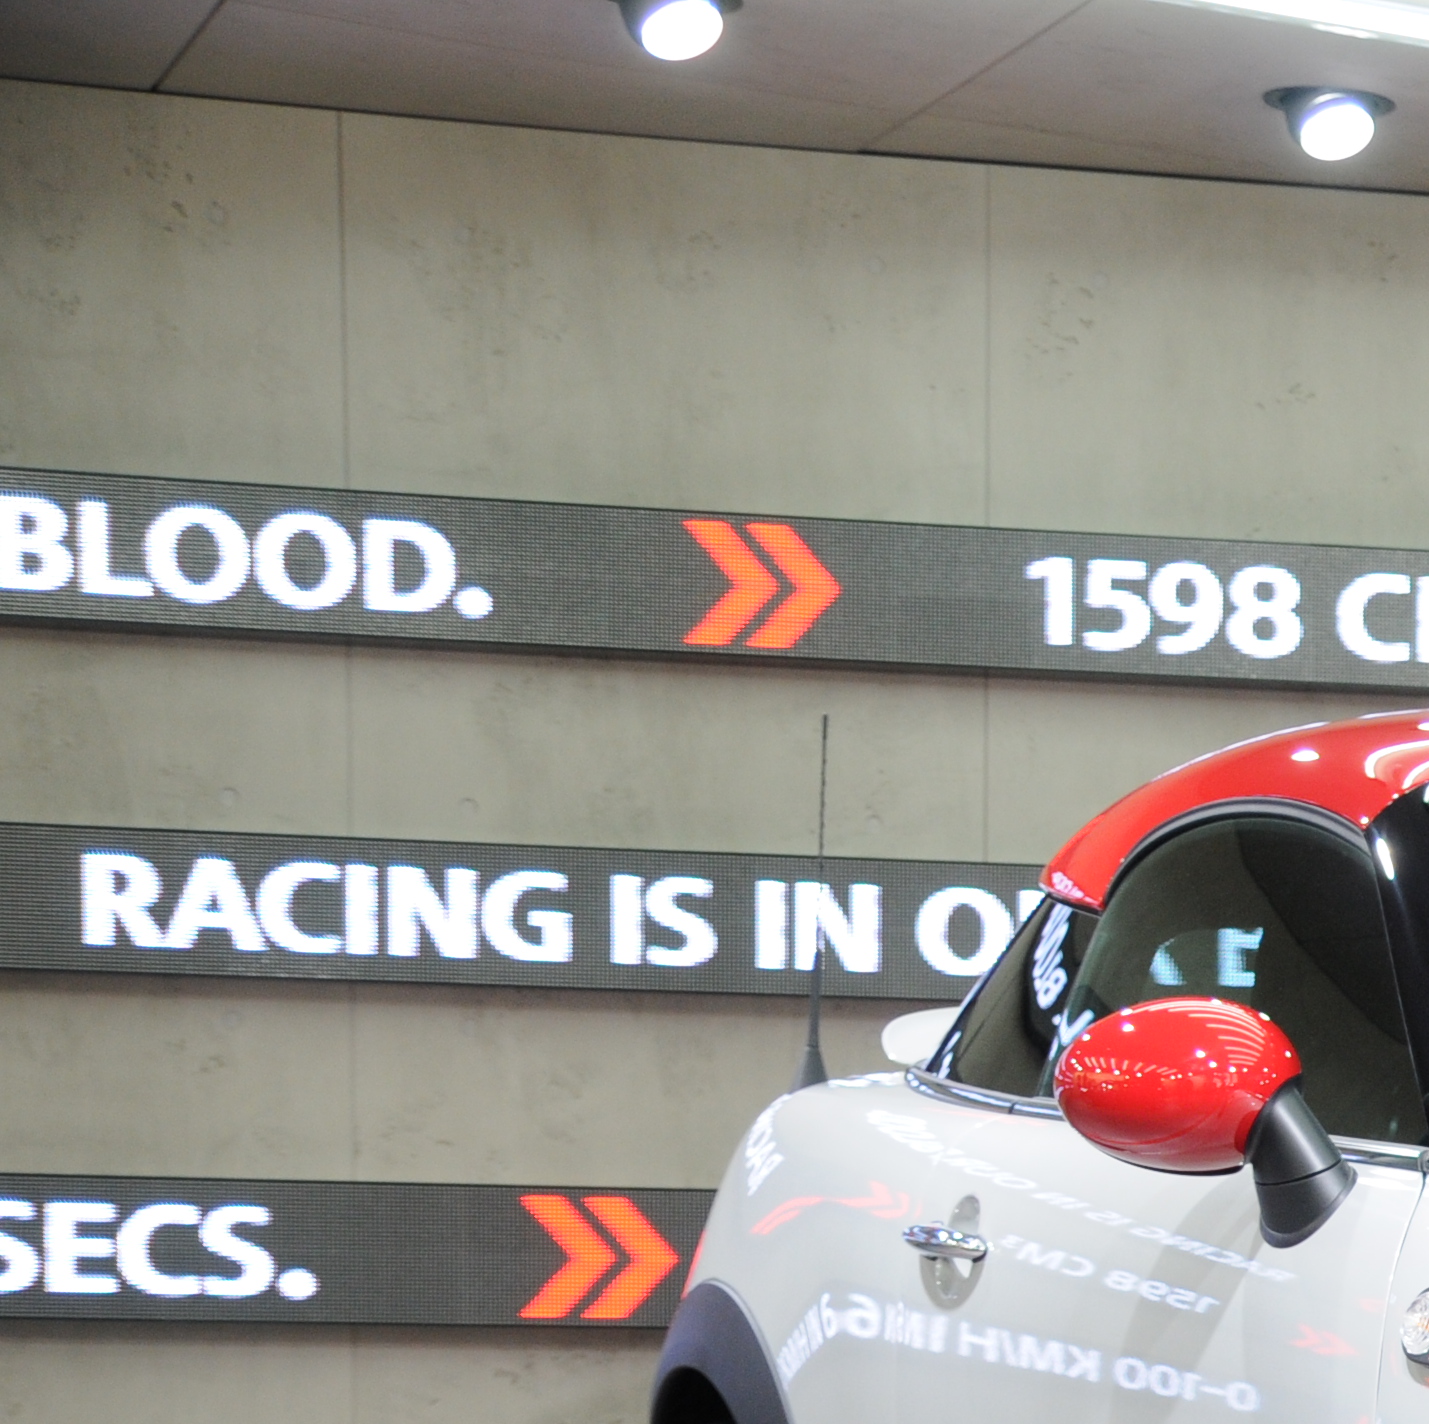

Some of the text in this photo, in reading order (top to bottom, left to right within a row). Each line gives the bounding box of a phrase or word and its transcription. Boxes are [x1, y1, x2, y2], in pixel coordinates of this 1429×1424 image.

[0, 494, 494, 619] BLOOD.
[1025, 556, 1305, 660] 1598
[79, 852, 574, 963] RACING
[609, 874, 719, 967] IS
[754, 880, 883, 973] IN
